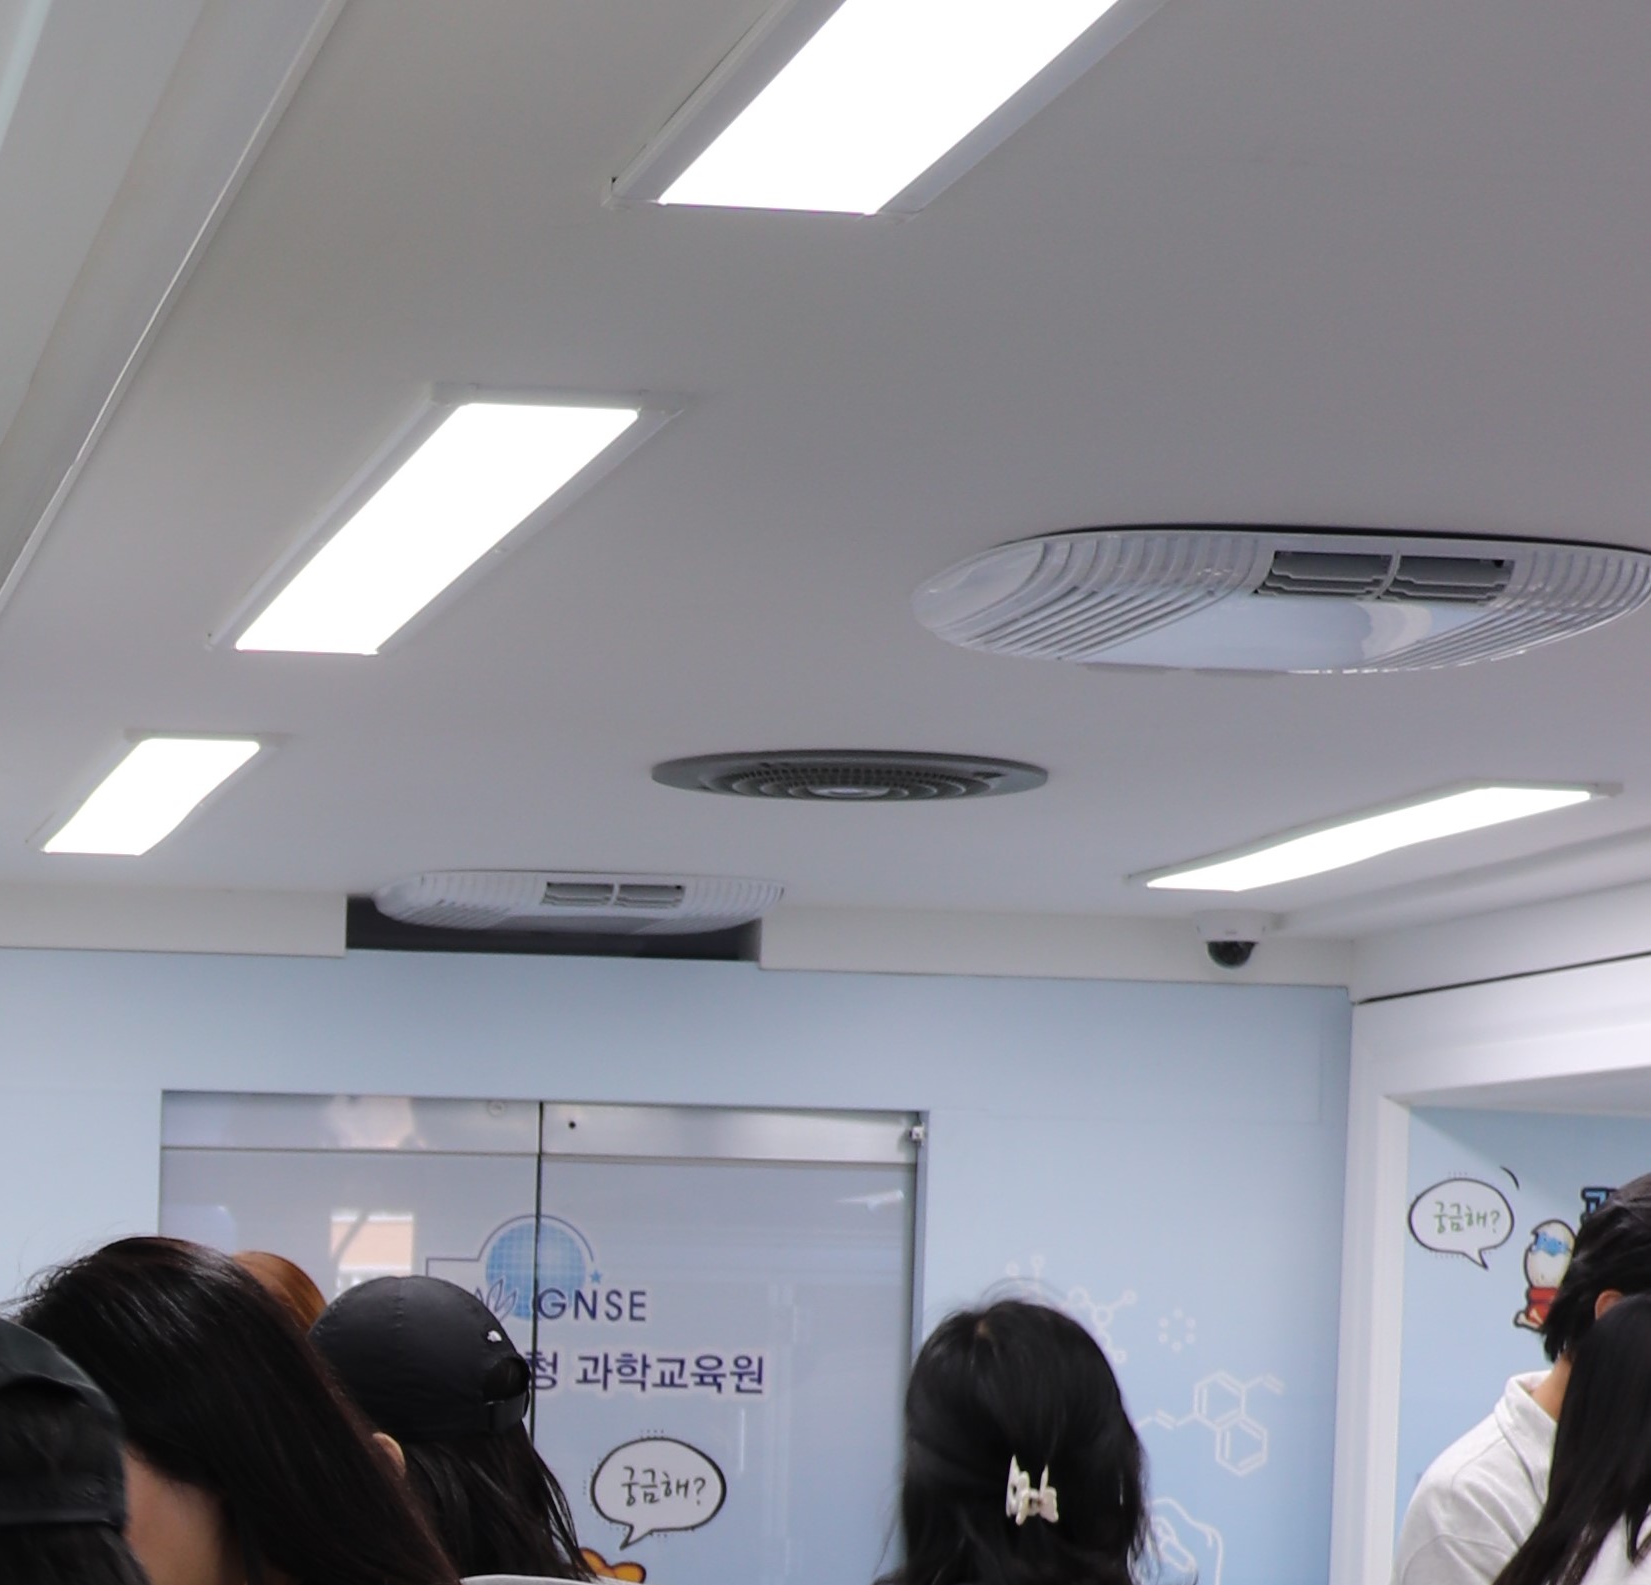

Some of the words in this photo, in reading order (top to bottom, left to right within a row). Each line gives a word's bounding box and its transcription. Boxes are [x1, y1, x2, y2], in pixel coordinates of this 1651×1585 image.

[1433, 1201, 1501, 1235] 궁금해?
[536, 1287, 647, 1322] GNSE
[525, 1352, 559, 1391] 청
[575, 1353, 765, 1394] 과학교육원
[621, 1466, 707, 1507] 궁금해?
